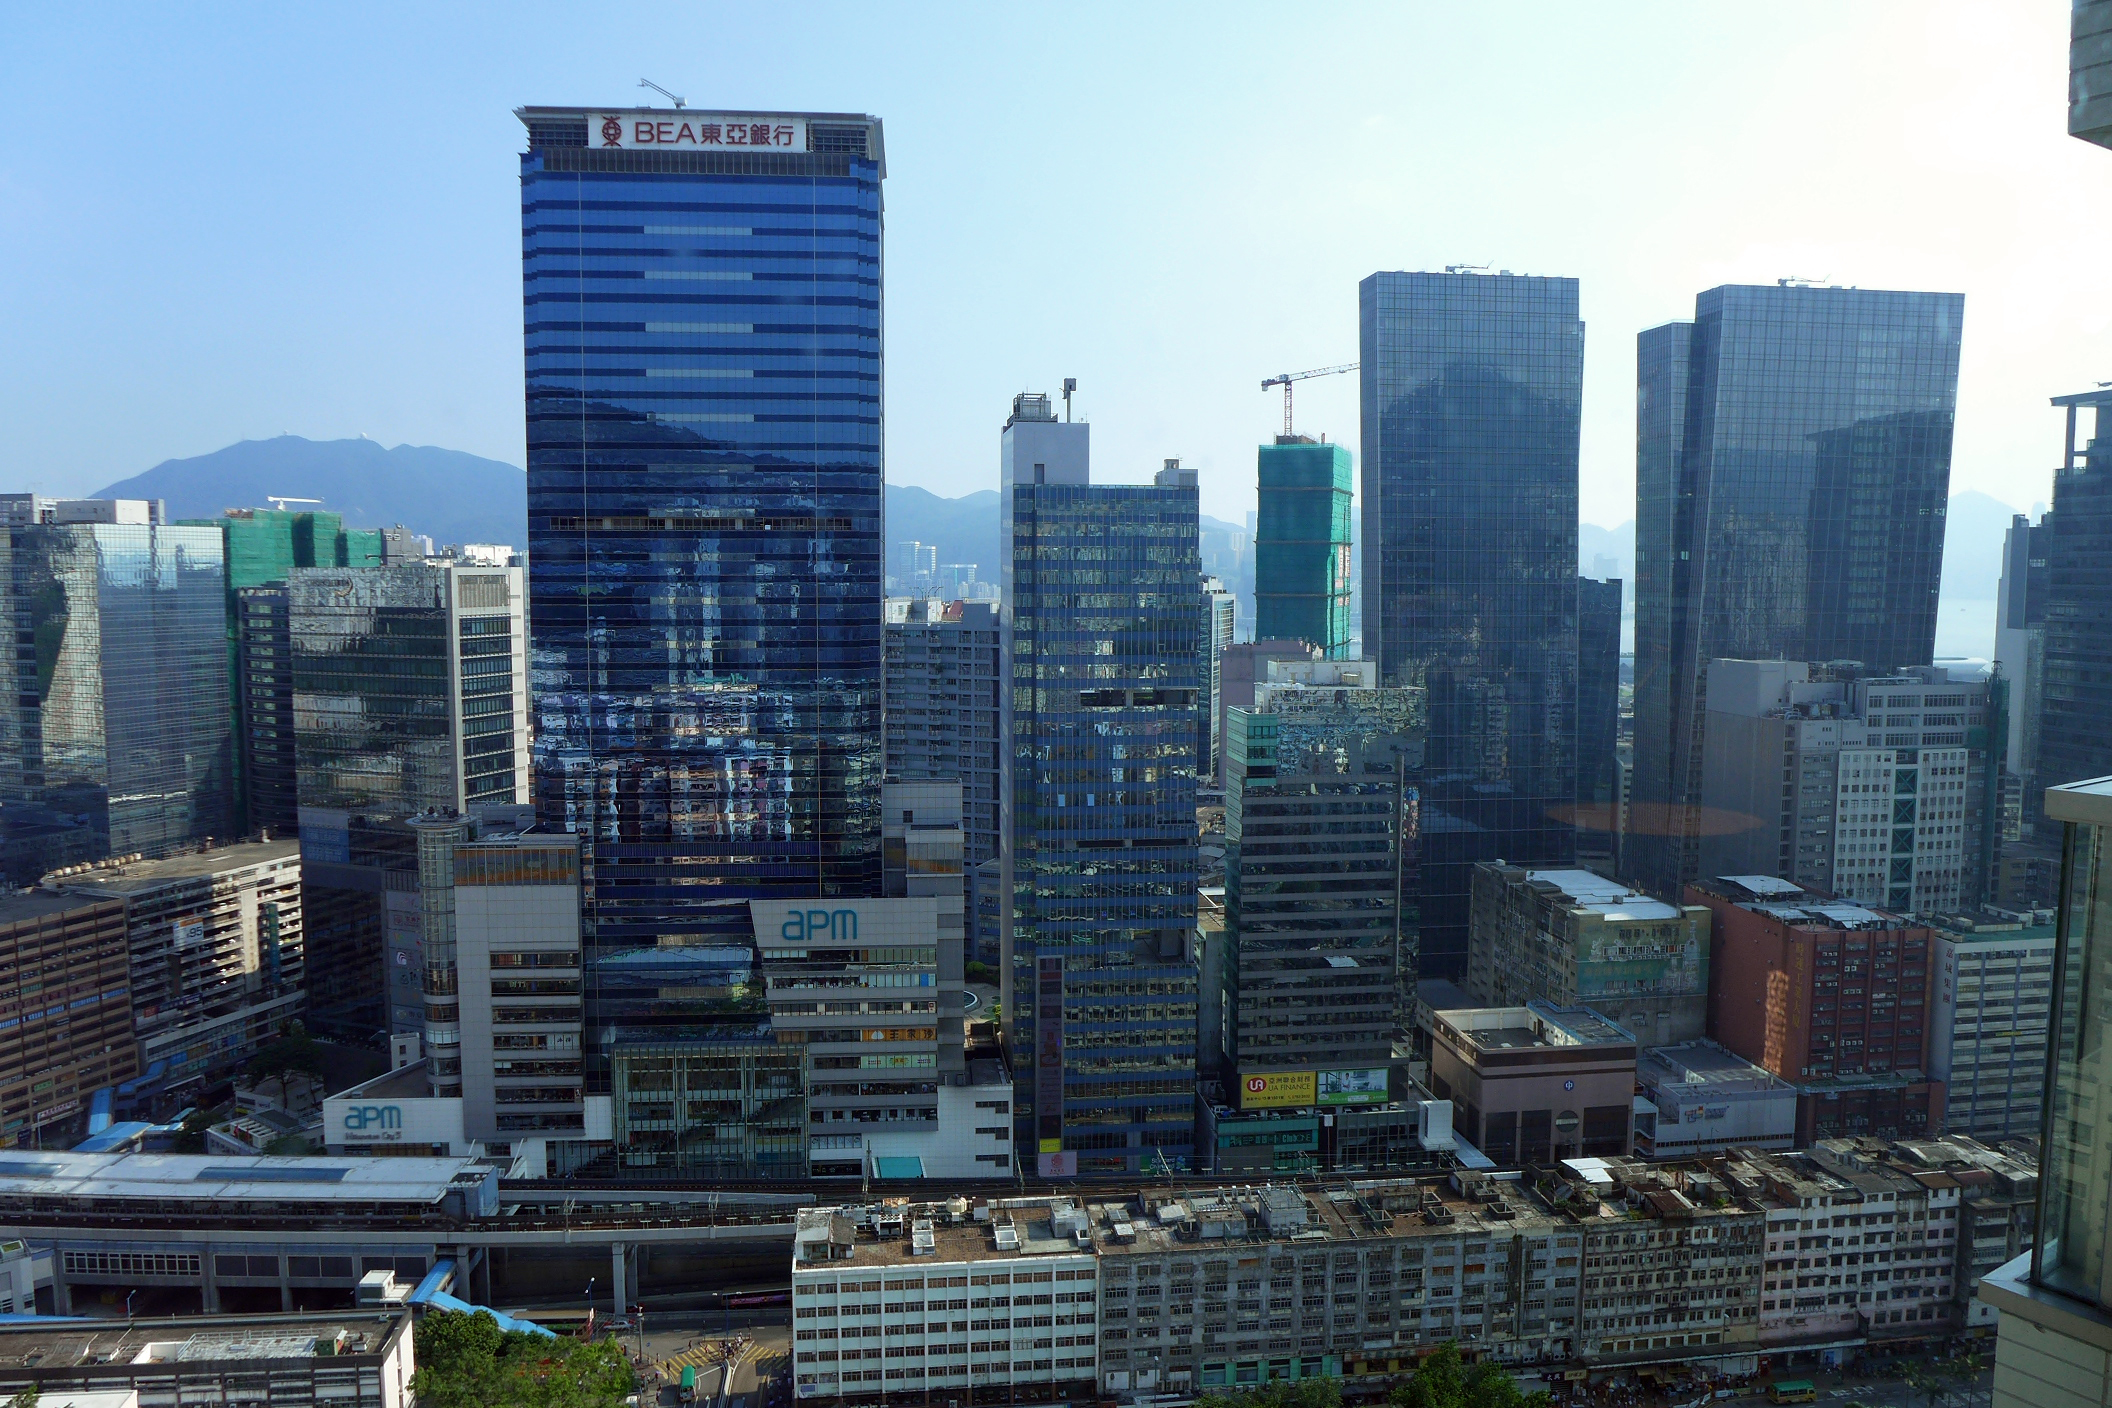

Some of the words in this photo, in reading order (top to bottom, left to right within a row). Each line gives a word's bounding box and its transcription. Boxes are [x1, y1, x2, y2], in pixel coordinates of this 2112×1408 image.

[634, 121, 697, 144] BEA
[700, 123, 794, 146] 東亞銀行
[781, 909, 858, 941] apm
[889, 1028, 934, 1039] 王家沙
[1280, 1083, 1311, 1091] FINANCE
[344, 1105, 402, 1129] apm
